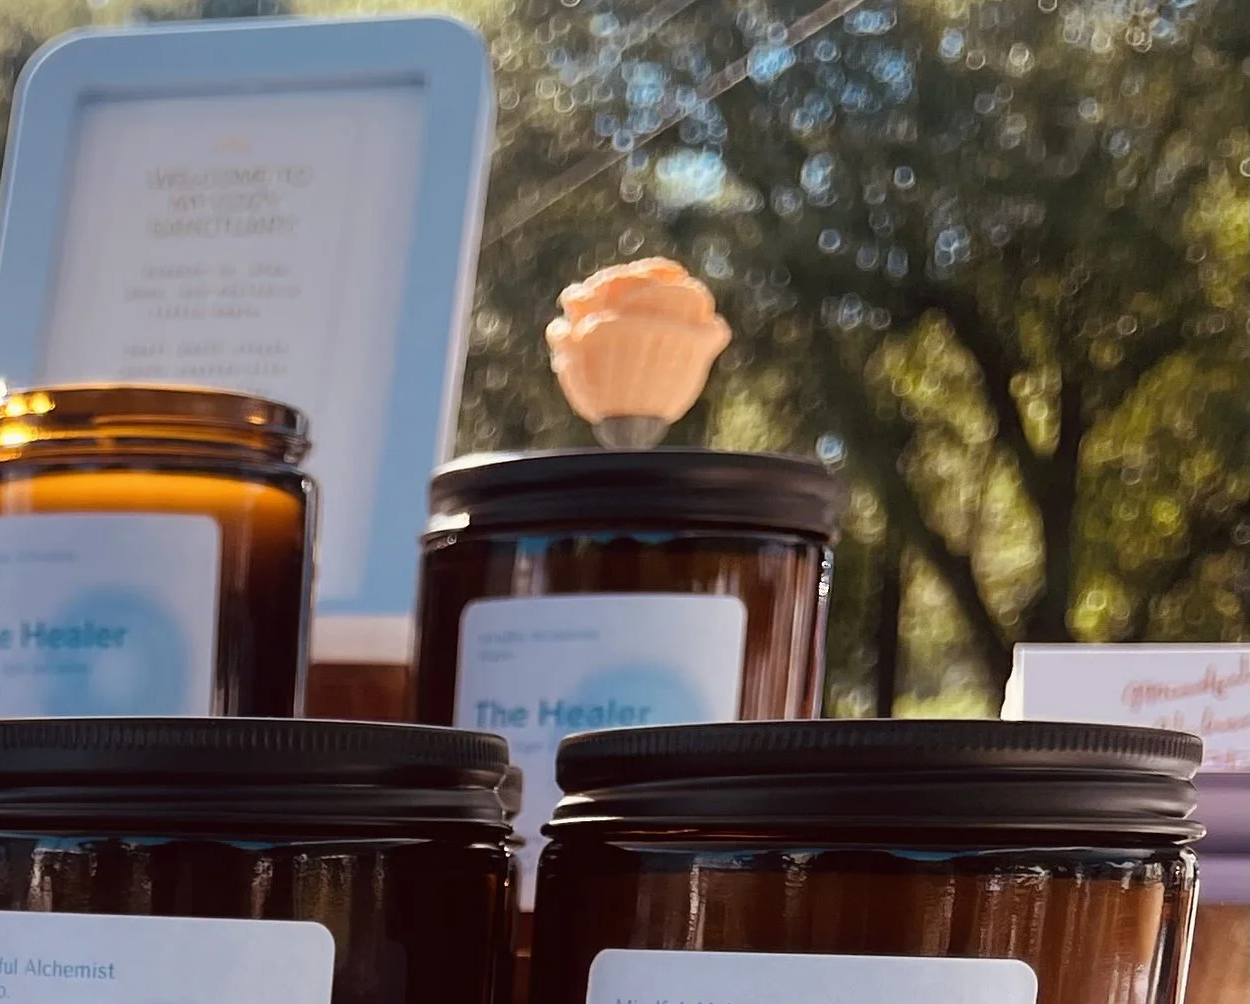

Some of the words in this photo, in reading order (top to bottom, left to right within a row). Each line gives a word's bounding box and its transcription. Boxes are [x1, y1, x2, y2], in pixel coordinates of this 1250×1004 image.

[19, 619, 130, 650] Healer
[475, 700, 530, 729] The
[536, 698, 652, 729] Healer
[24, 958, 116, 980] Alchemist
